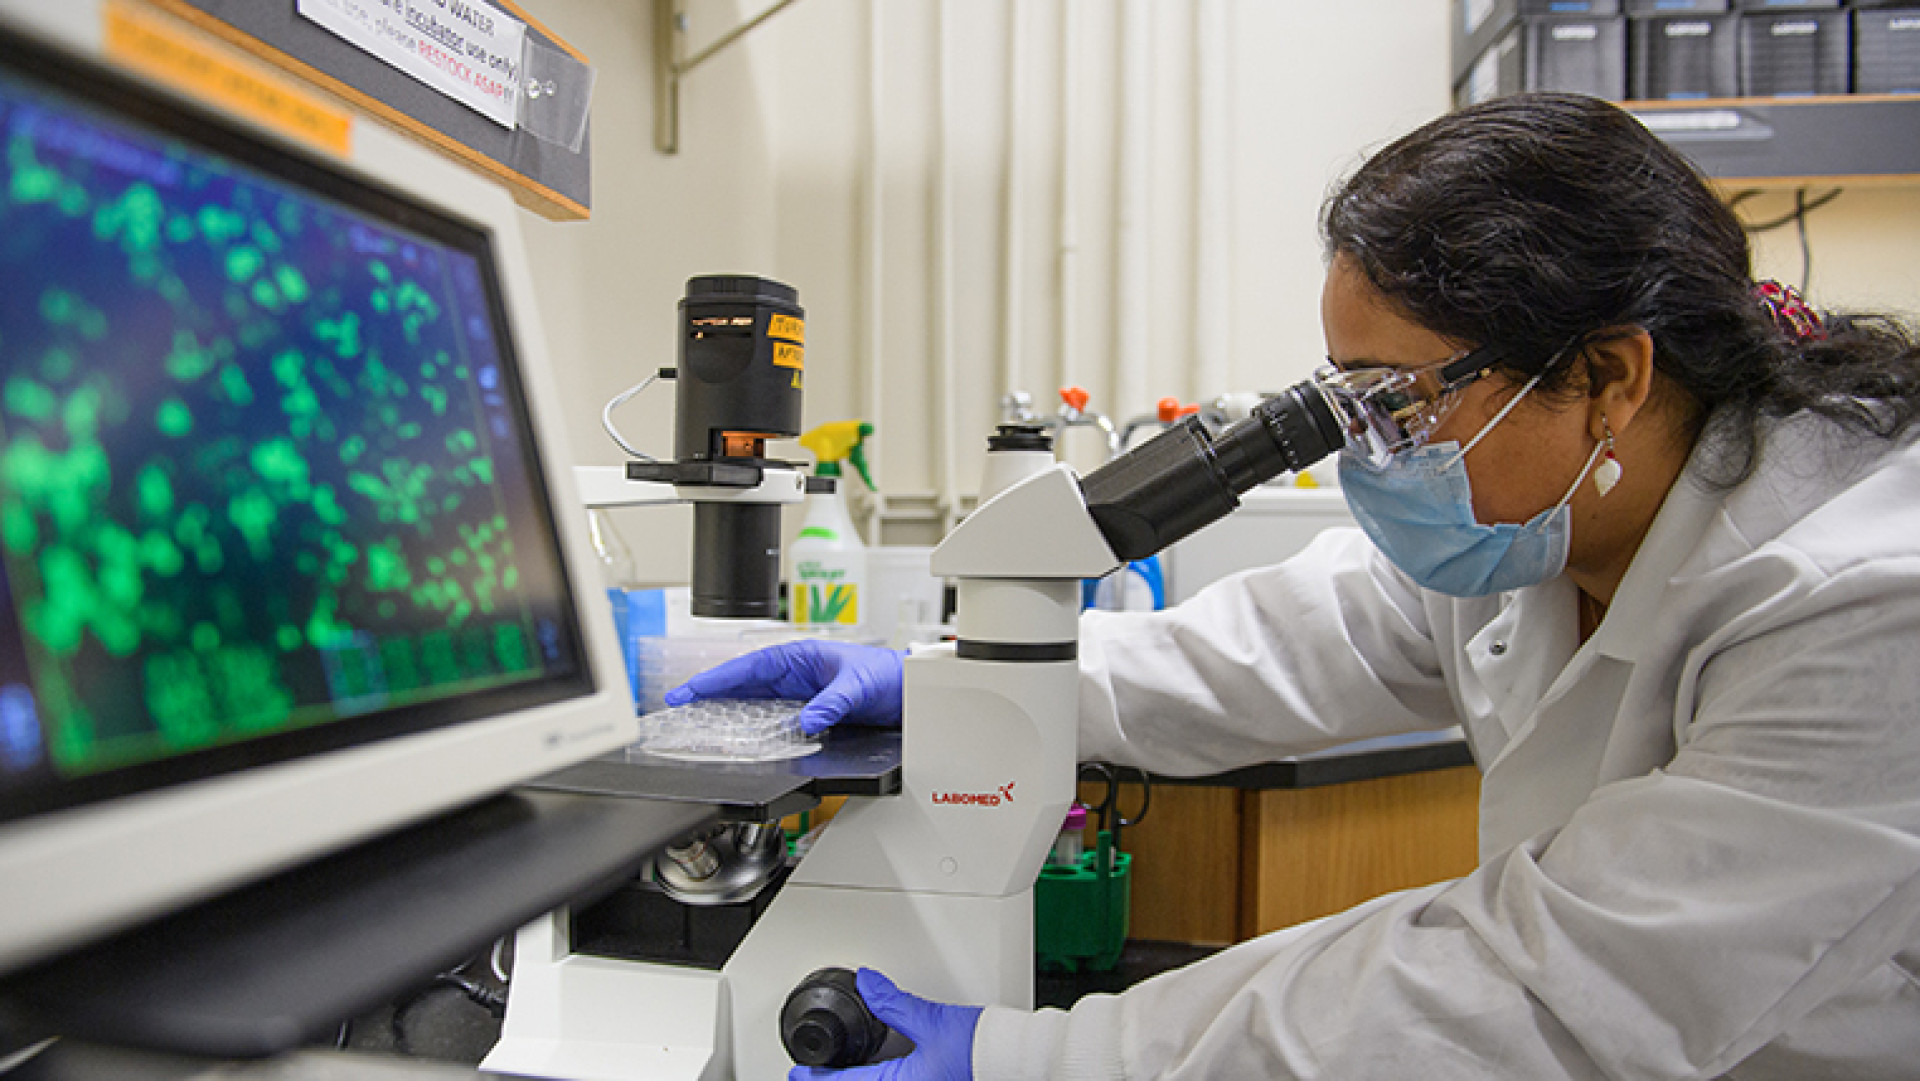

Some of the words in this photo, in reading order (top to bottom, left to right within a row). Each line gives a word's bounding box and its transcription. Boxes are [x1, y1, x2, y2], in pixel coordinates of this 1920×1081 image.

[449, 0, 494, 37] WATER
[375, 17, 416, 52] please
[417, 39, 472, 83] RESTOCK
[466, 42, 487, 64] use
[931, 791, 1001, 806] LABOMED
